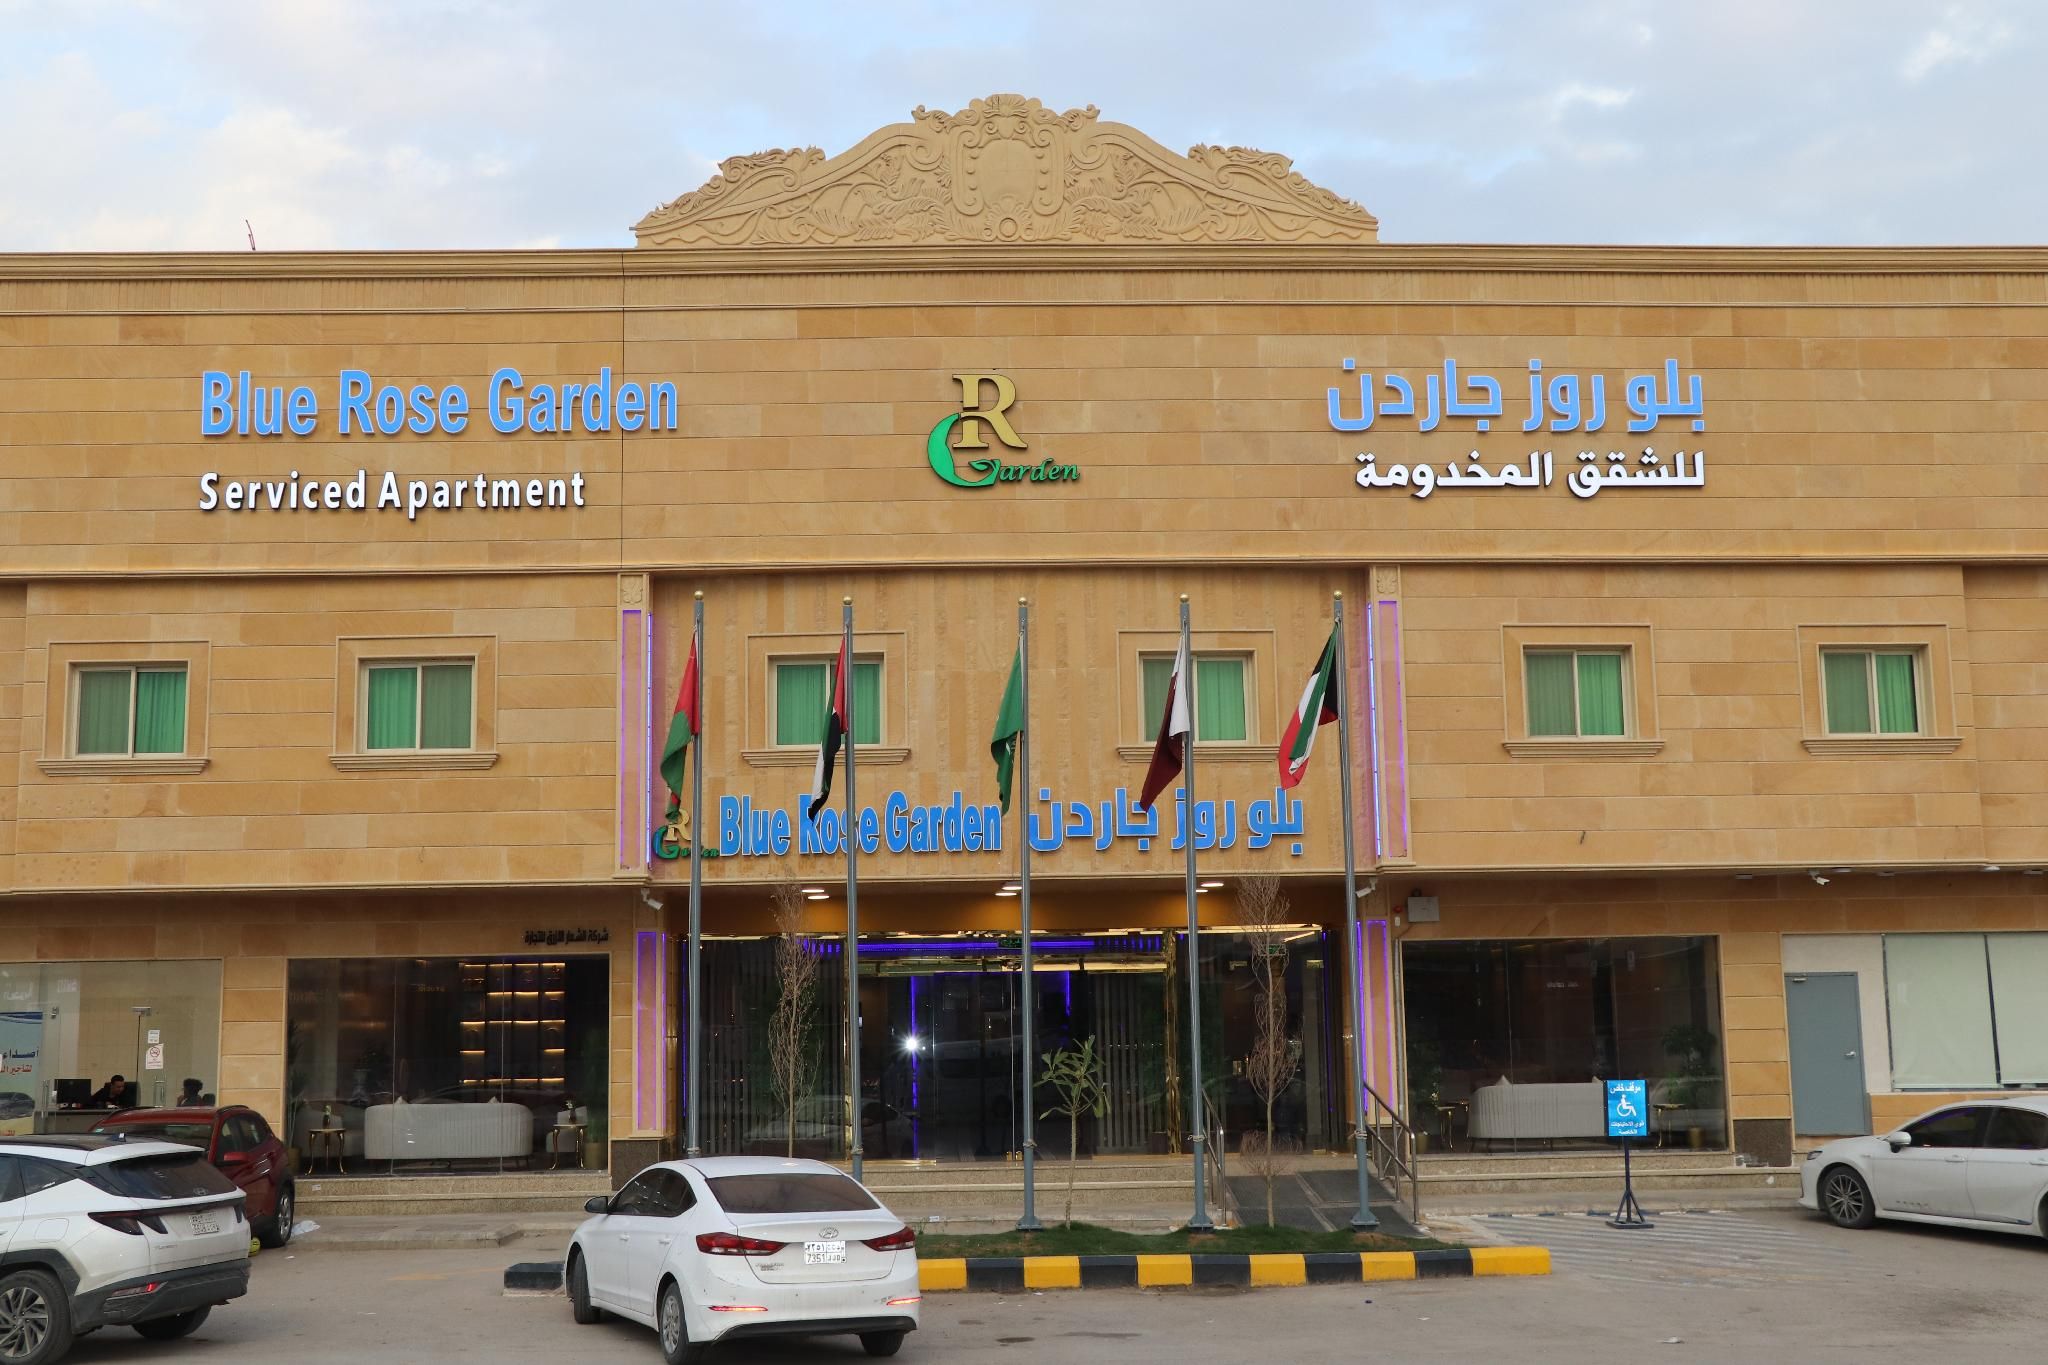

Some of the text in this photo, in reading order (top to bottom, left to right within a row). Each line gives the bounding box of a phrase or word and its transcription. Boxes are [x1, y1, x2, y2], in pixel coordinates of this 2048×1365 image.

[201, 366, 678, 435] Blue Rose Garden
[951, 373, 1028, 450] R
[1327, 357, 1705, 433] بلو روز جاردن
[927, 412, 1081, 488] Garden
[1354, 446, 1705, 499] للشقق المخدومة
[199, 468, 586, 521] Serviced Apartment
[719, 794, 791, 857] Blue
[885, 790, 1003, 853] Garden
[1028, 786, 1304, 856] بلو روز جاردن
[1610, 1082, 1642, 1094] موقف خاص
[806, 1253, 827, 1263] 7351
